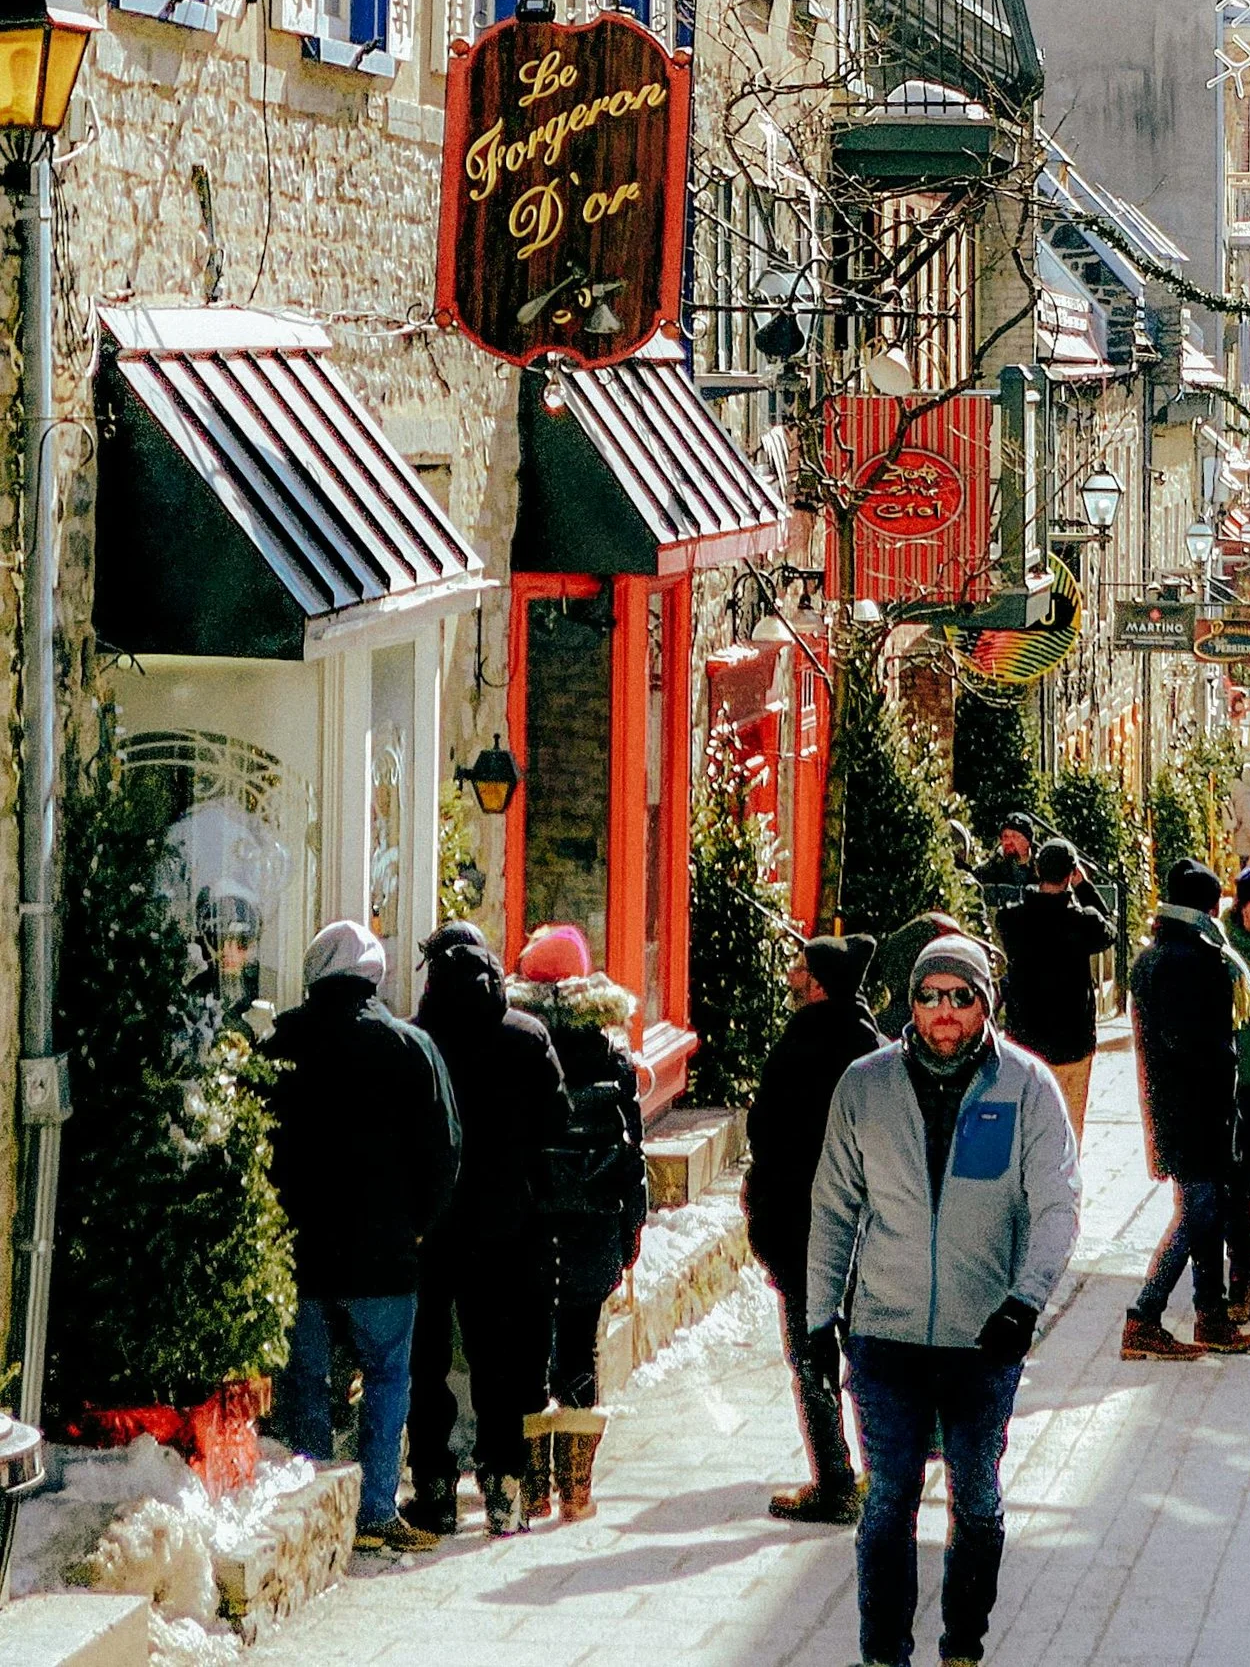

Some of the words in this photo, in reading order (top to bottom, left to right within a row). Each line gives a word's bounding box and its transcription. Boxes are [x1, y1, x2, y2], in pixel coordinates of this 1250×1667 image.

[518, 50, 577, 107] Le
[466, 83, 667, 201] Forgeron
[509, 172, 641, 260] D'or
[1126, 622, 1184, 634] MARTINO
